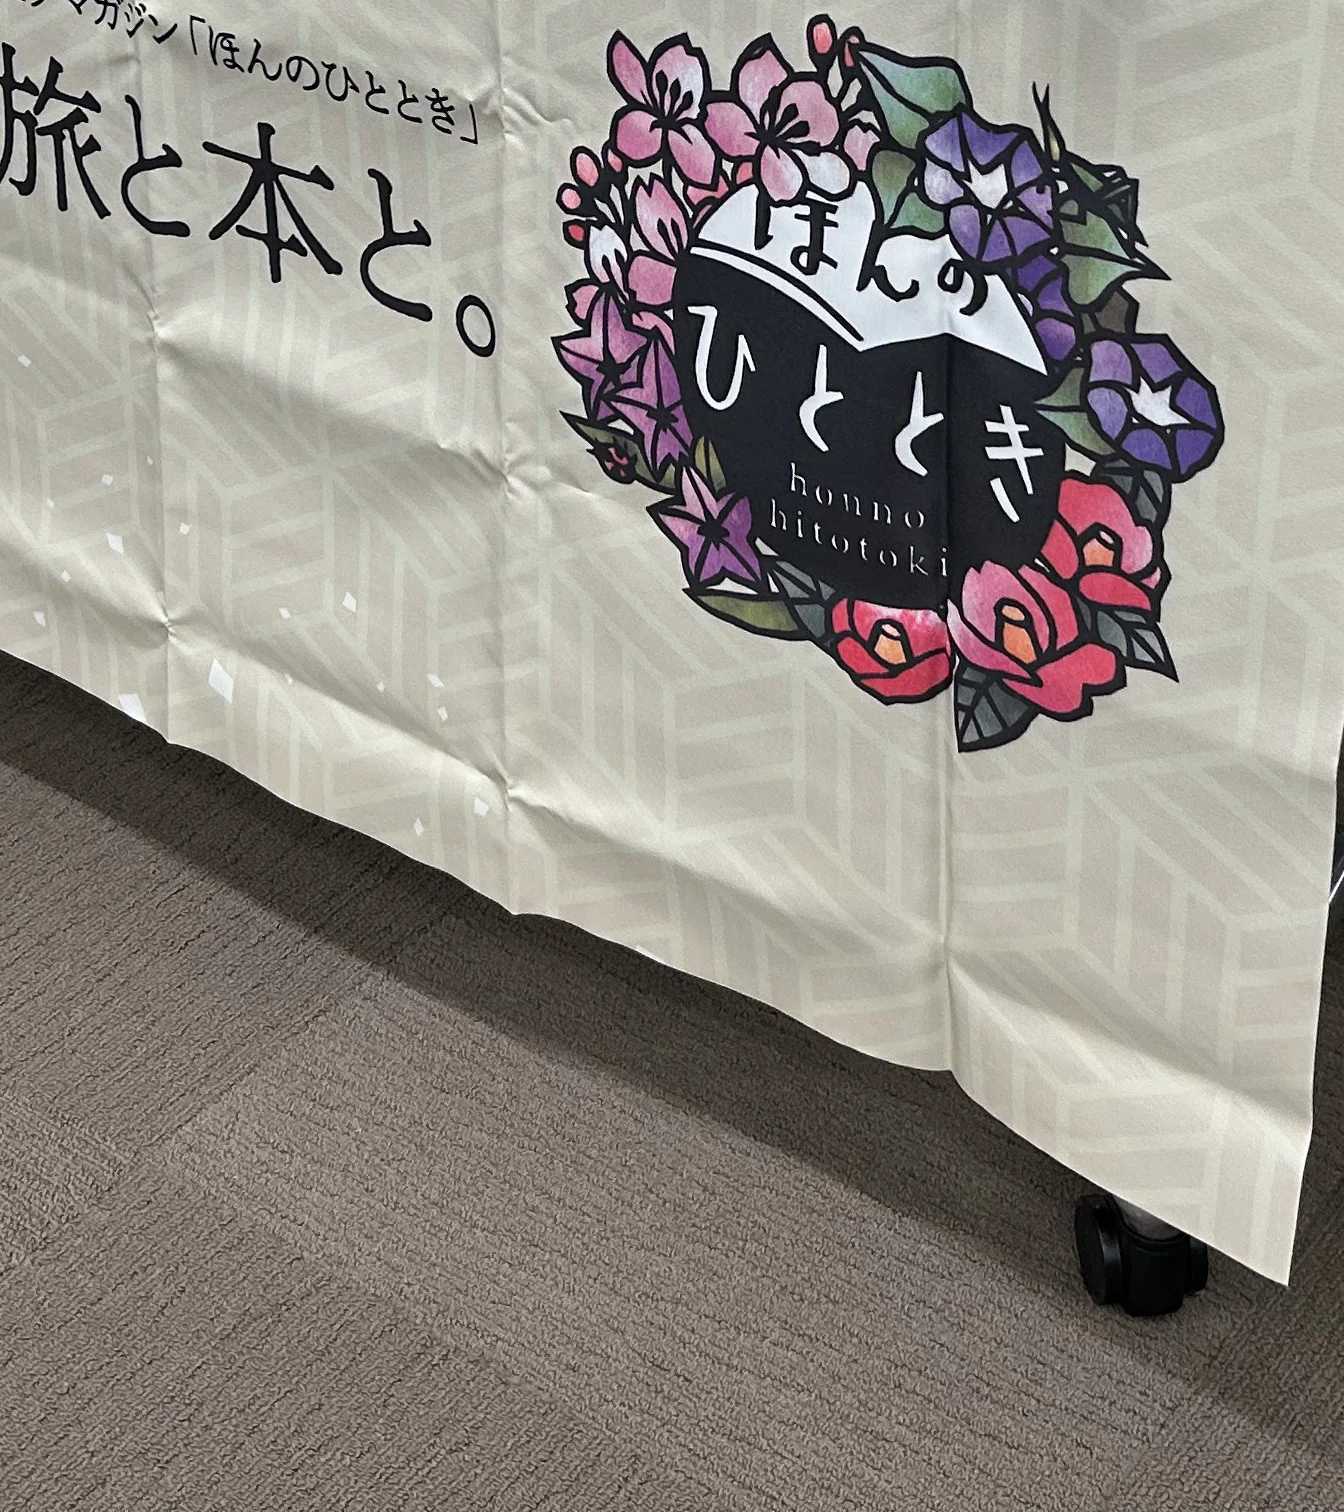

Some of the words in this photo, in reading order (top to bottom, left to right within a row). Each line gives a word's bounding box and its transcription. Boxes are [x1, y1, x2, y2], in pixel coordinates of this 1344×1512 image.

[755, 188, 985, 315] ほんの
[687, 304, 1045, 524] ひととき
[770, 498, 953, 578] hitotoki
[789, 462, 927, 531] honno
